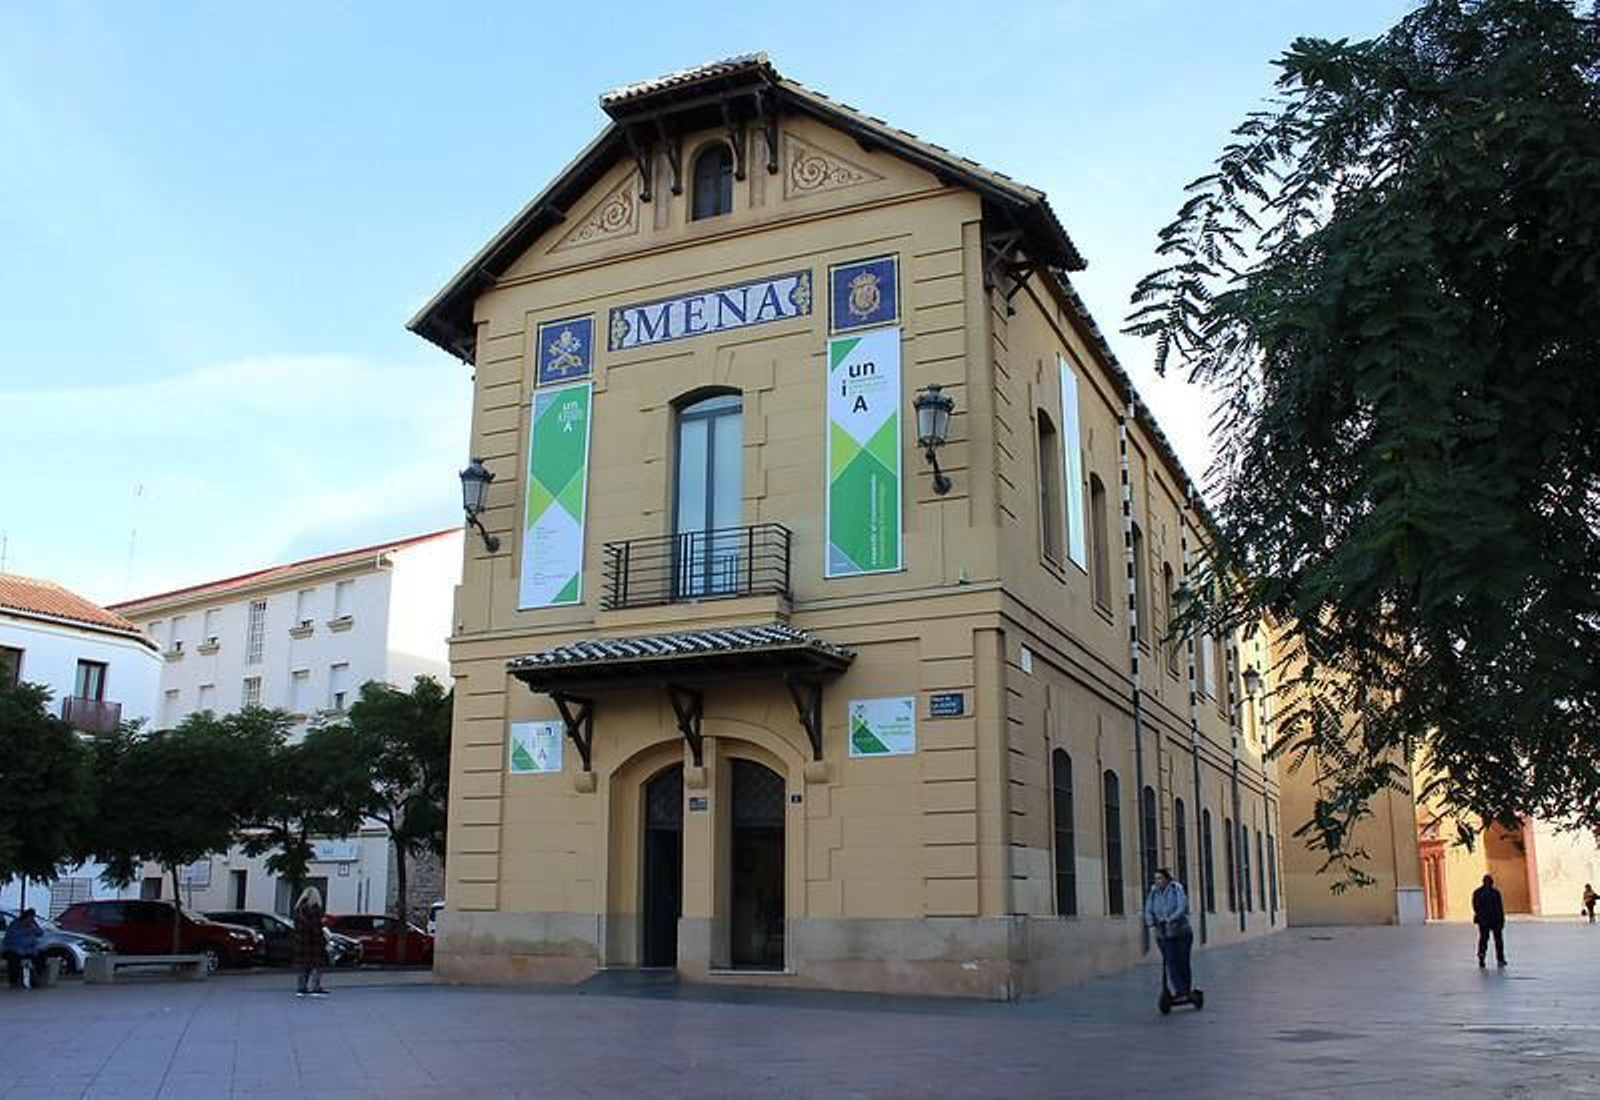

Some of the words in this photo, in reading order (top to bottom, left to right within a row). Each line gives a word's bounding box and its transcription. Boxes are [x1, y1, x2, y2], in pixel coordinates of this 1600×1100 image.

[635, 284, 786, 342] MENA
[848, 362, 875, 378] un
[841, 380, 847, 397] i
[852, 395, 868, 413] A
